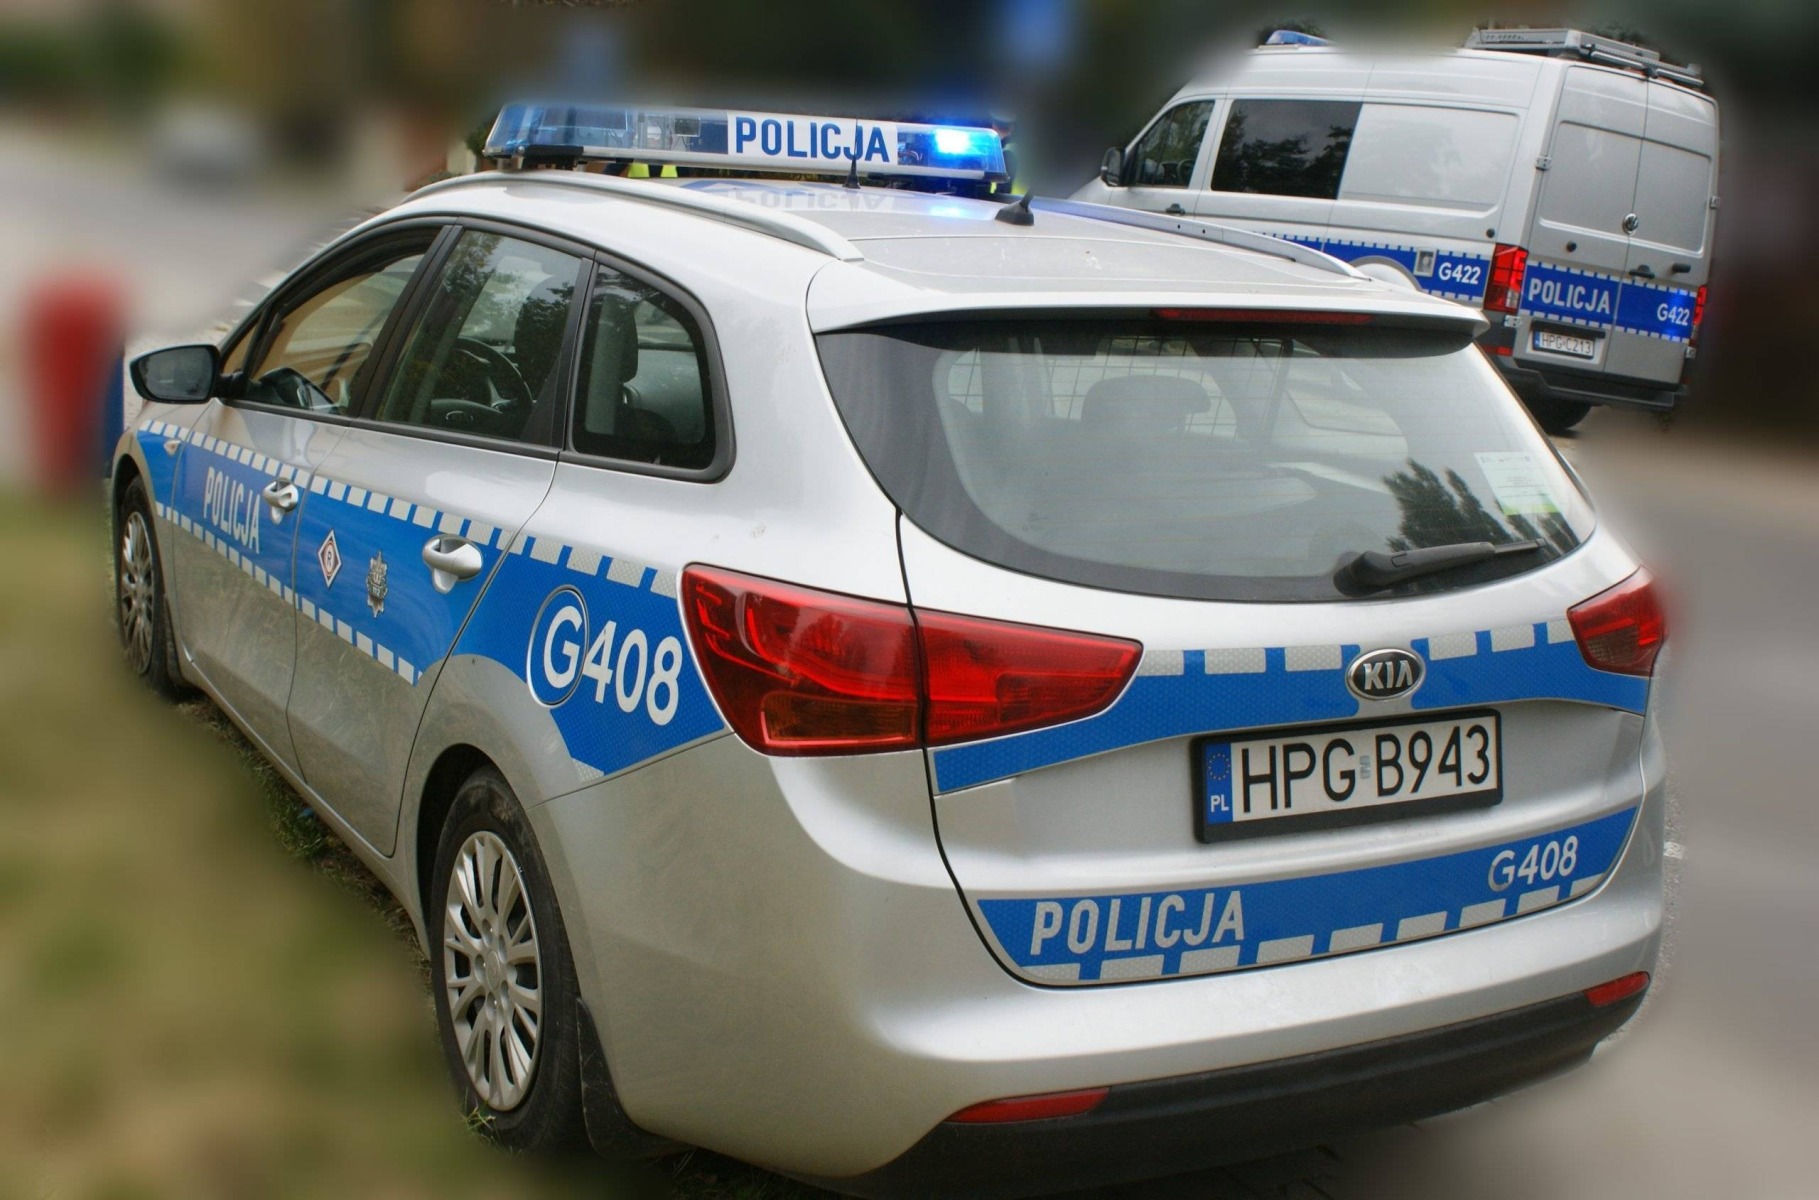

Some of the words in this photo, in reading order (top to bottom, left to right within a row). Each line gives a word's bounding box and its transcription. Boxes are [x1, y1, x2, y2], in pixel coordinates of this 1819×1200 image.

[735, 116, 890, 162] POLICJA
[1438, 262, 1482, 285] G422
[1529, 278, 1611, 315] POLICJA
[1657, 303, 1691, 326] G422
[204, 466, 261, 554] POLICJA
[543, 605, 683, 726] G408
[1363, 659, 1413, 690] KIA
[1241, 738, 1356, 813] HPG
[1375, 724, 1490, 797] B943
[1210, 794, 1229, 813] PL
[1488, 836, 1578, 891] G408
[1030, 890, 1245, 955] POLICJA
